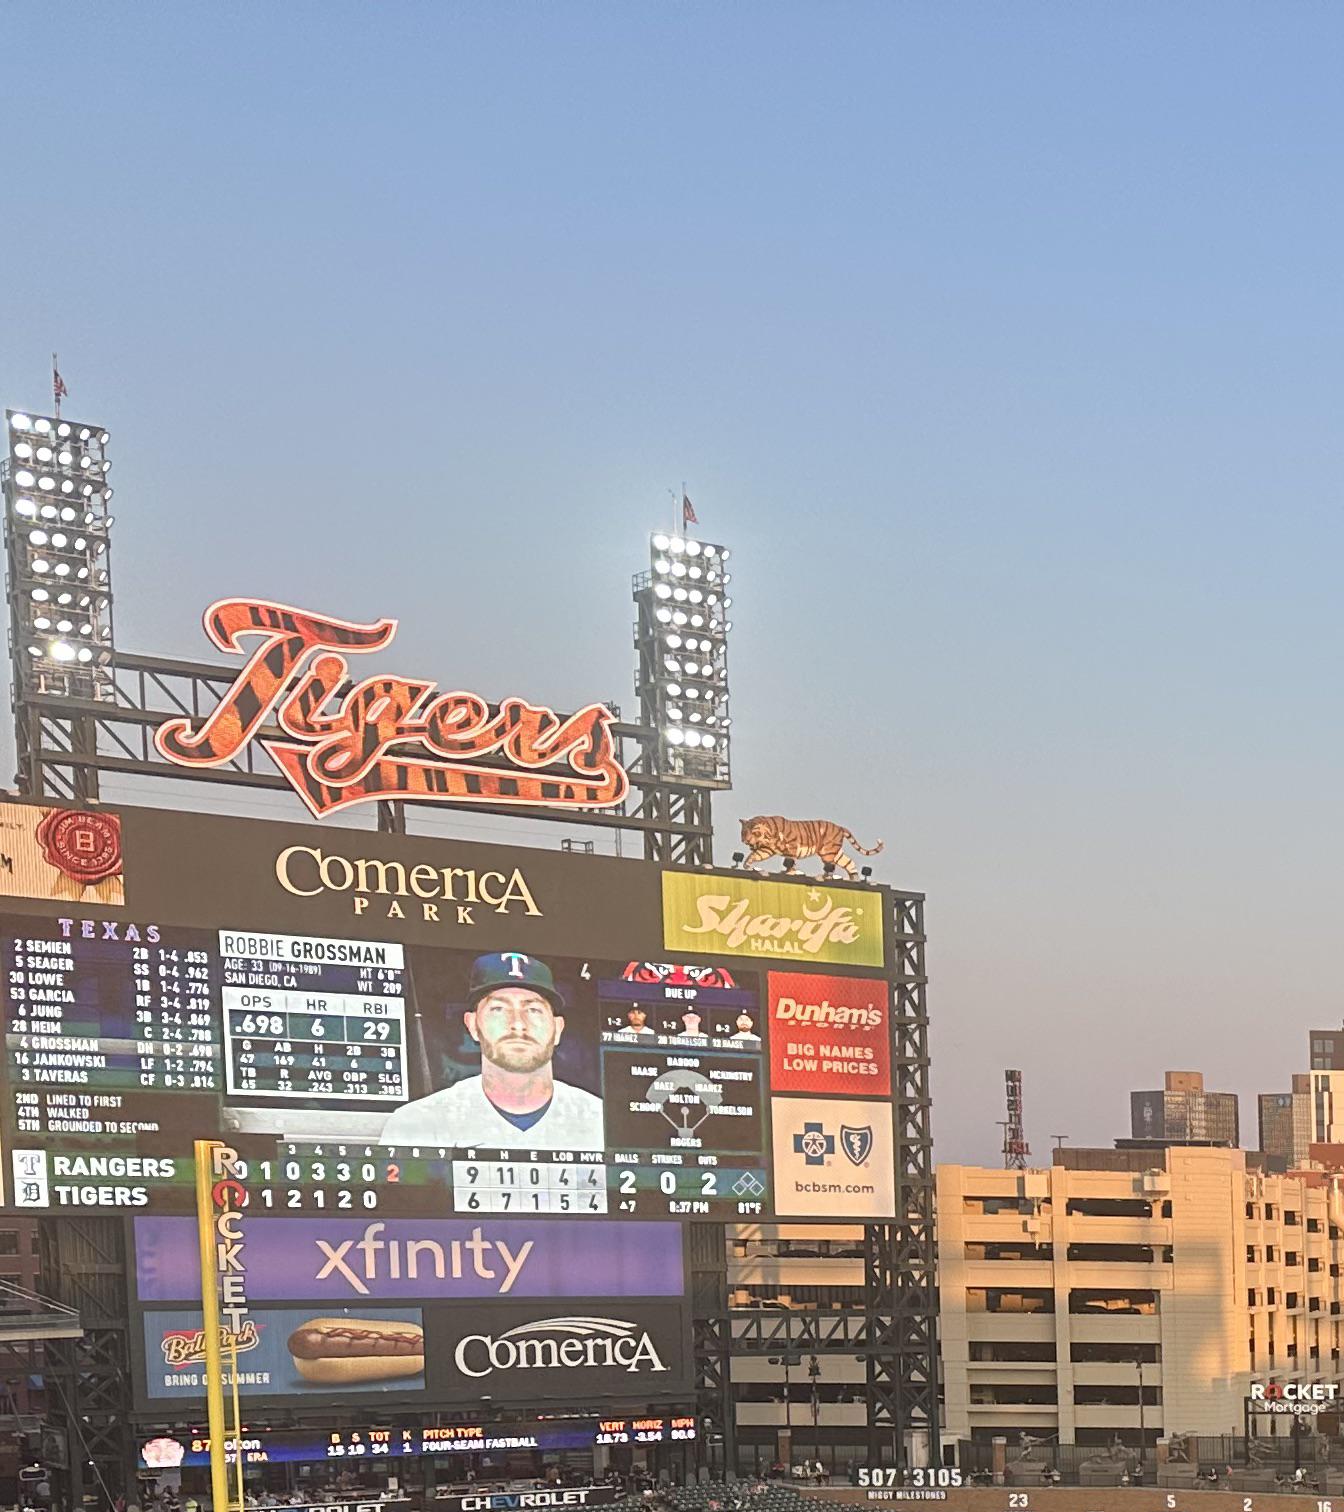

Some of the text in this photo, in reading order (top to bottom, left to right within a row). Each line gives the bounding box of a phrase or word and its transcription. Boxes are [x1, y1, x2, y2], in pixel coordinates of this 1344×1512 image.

[155, 597, 630, 819] Tigers
[276, 845, 543, 917] Comerica
[353, 897, 475, 925] PARK
[58, 918, 161, 943] TEXAS
[682, 894, 863, 953] Sharifa
[26, 940, 71, 955] SEMIEN
[225, 936, 386, 964] ROBBIE GROSSMAN
[751, 938, 803, 954] HALAL
[27, 956, 74, 971] SEAGER
[29, 972, 64, 986] LOWE
[29, 988, 75, 1003] GARCIA
[241, 994, 272, 1008] OPS
[30, 1005, 62, 1018] JUNG
[306, 999, 327, 1011] HR
[364, 1002, 388, 1015] RBI
[776, 997, 882, 1026] Dunham's
[31, 1021, 62, 1034] HEIM
[235, 1015, 284, 1034] .698
[364, 1022, 390, 1040] 29
[32, 1037, 99, 1051] GROSSMAN
[787, 1043, 874, 1060] BIG NAMES
[33, 1052, 106, 1067] JANKOWSKI
[783, 1058, 880, 1075] LOW PRICES
[34, 1068, 88, 1083] TAVERAS
[47, 1094, 122, 1108] LINED FIRST
[47, 1108, 89, 1119] WALKED
[48, 1120, 102, 1132] GROUNDED
[54, 1157, 175, 1177] RANGERS
[615, 1154, 683, 1165] BALLS STRIKES
[497, 1167, 514, 1184] 11
[795, 1180, 875, 1195] bcbsm.com
[55, 1187, 148, 1206] TIGERS
[212, 1147, 249, 1335] ROCKET
[315, 1222, 535, 1294] xfinity
[455, 1332, 667, 1376] Comerica
[165, 1374, 197, 1386] BRING
[1252, 1383, 1338, 1400] ROCKET
[1265, 1401, 1326, 1415] Mortgage
[423, 1420, 663, 1438] PITCH TYPE VERT HORIZ
[422, 1437, 538, 1451] FOUR-SEAM FASTBALL
[858, 1468, 897, 1487] 507
[913, 1468, 962, 1487] 3105
[461, 1490, 589, 1511] CHEVROLET
[897, 1490, 946, 1500] MILESTONES
[1009, 1494, 1028, 1508] 23
[1168, 1495, 1176, 1508] 5
[1243, 1499, 1252, 1512] 2
